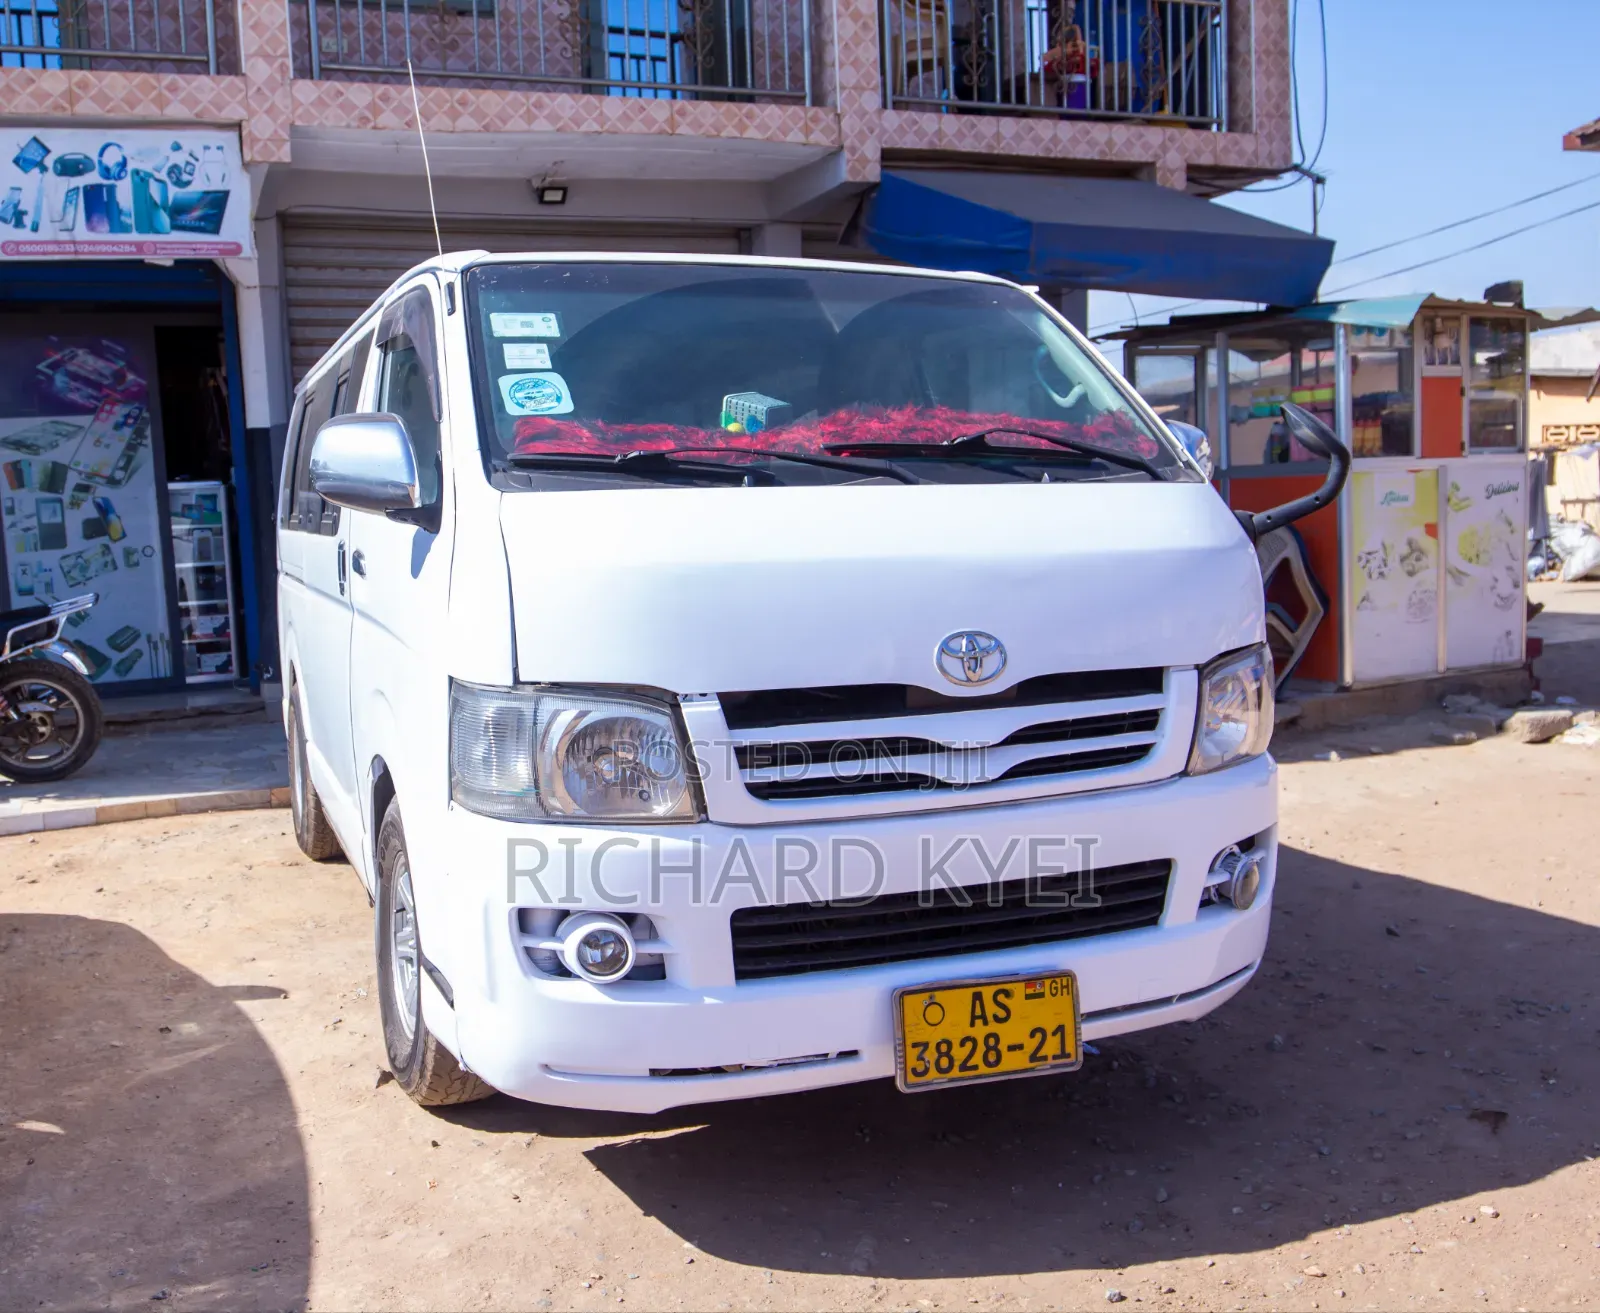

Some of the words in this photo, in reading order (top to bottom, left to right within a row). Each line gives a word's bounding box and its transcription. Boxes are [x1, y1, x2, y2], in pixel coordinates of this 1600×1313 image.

[969, 988, 1015, 1028] AS
[1049, 978, 1071, 998] GH
[910, 1024, 1072, 1078] 3828-21
